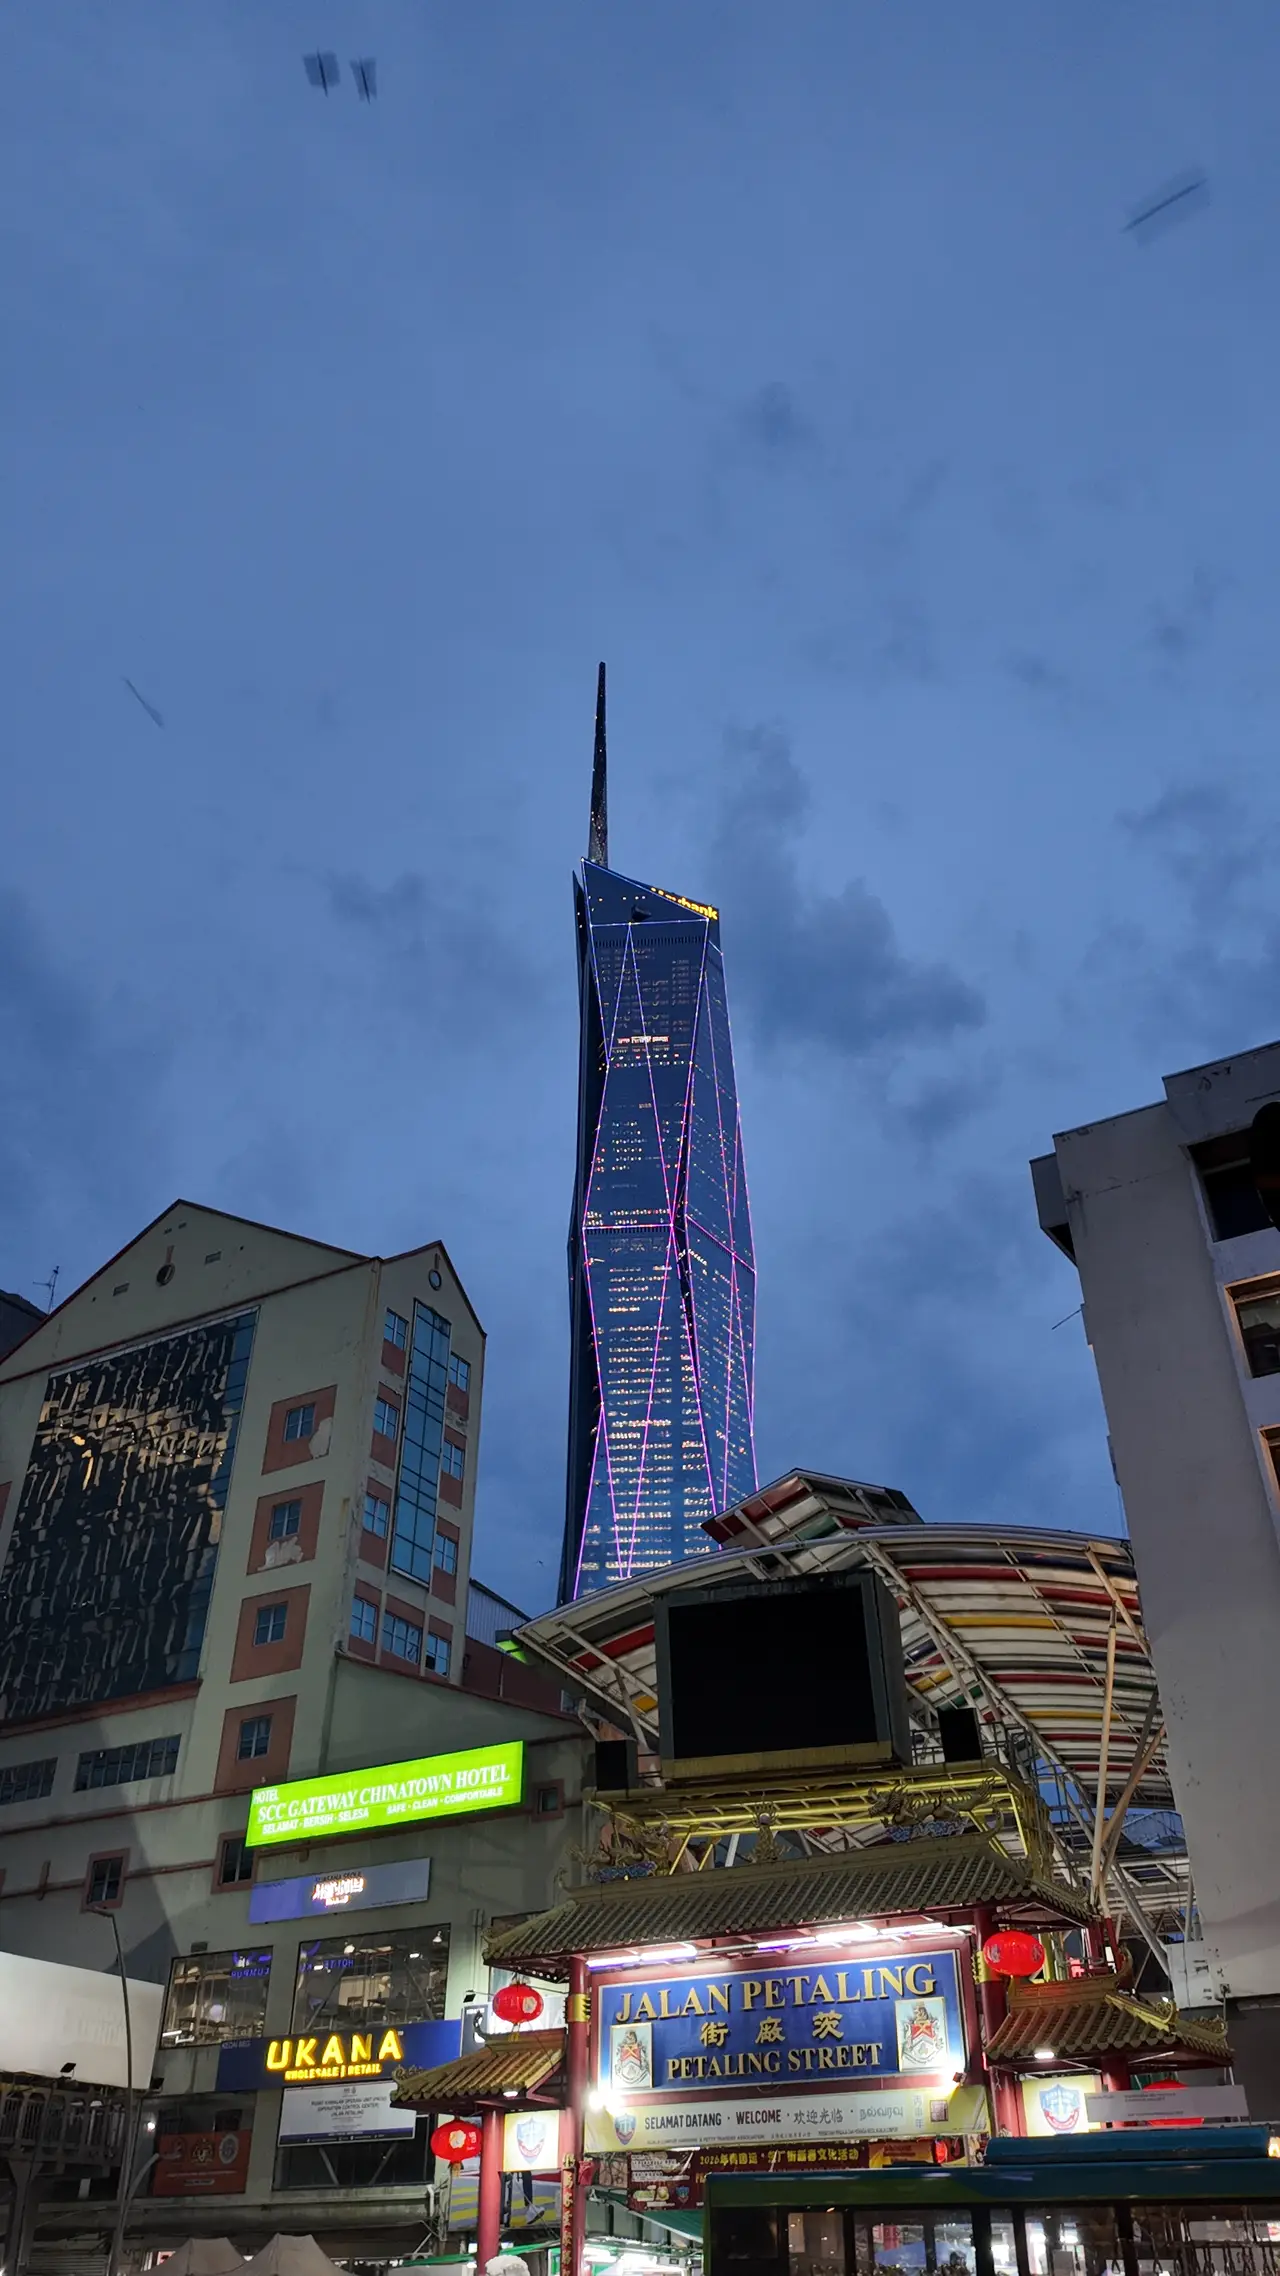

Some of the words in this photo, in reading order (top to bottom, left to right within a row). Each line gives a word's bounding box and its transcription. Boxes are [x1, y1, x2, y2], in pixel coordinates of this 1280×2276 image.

[253, 1788, 279, 1805] HOTEL
[258, 1803, 286, 1823] SCC
[288, 1790, 358, 1818] GATEWAY
[359, 1773, 453, 1805] CHINATOWN
[455, 1763, 510, 1789] HOTEL
[386, 1802, 407, 1816] SAFE
[412, 1797, 438, 1811] CLEAN
[262, 1819, 299, 1835] SELAMAT
[303, 1813, 334, 1829] BERSIH
[337, 1806, 369, 1823] SELESA
[616, 1983, 732, 2023] JALAN
[741, 1963, 937, 2010] PETALING
[266, 2029, 402, 2072] UKANA
[667, 2050, 782, 2081] PETALING
[787, 2043, 883, 2072] STREET
[284, 2067, 339, 2081] WHOLESALE
[347, 2063, 382, 2076] RETAIL
[645, 2114, 685, 2130] SELAMAT
[686, 2112, 722, 2128] DATANG
[736, 2109, 782, 2125] WELCOME
[793, 2107, 844, 2125] 欢迎光临
